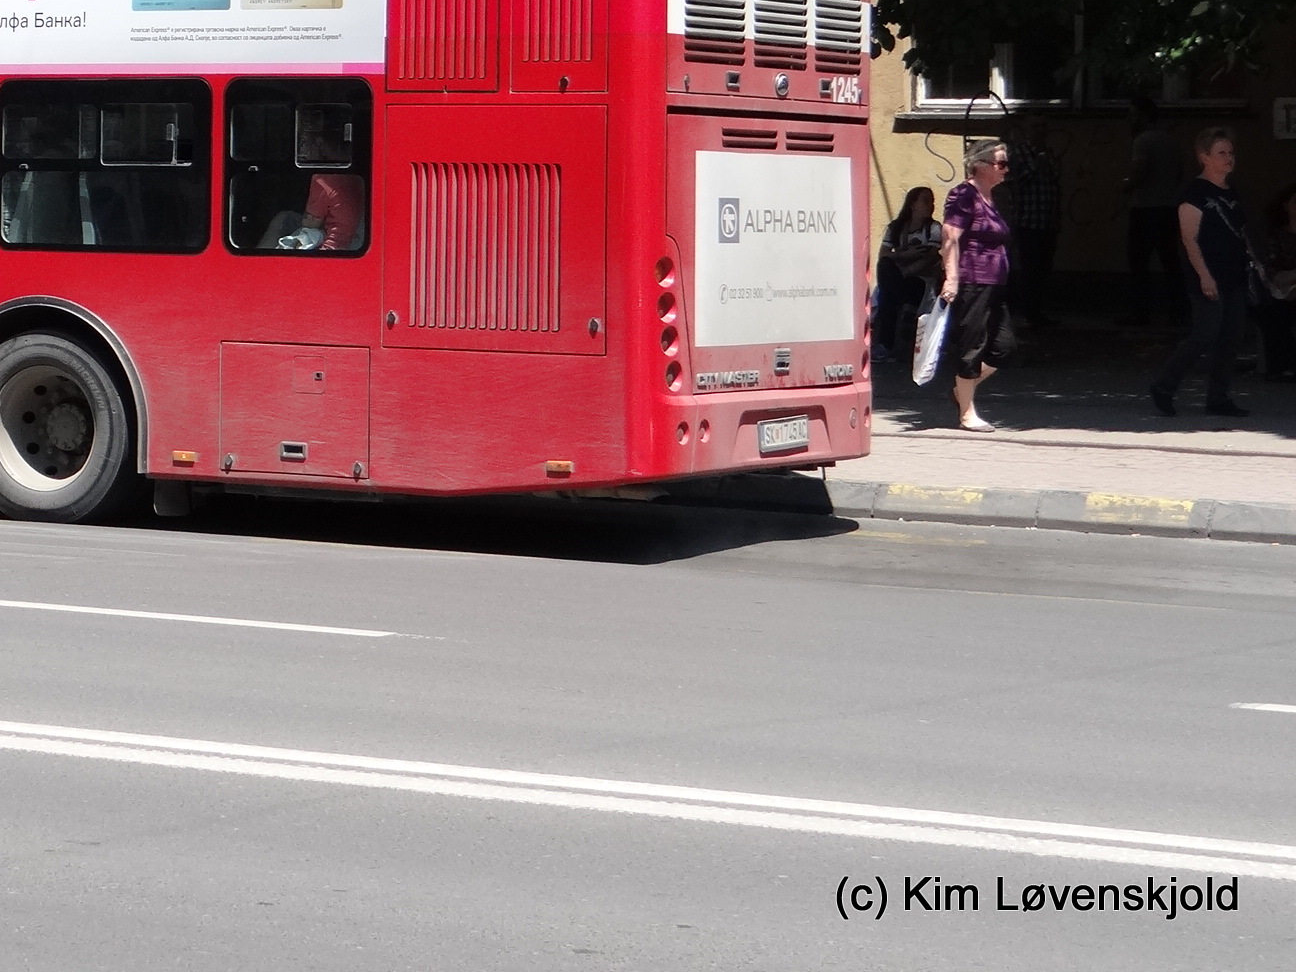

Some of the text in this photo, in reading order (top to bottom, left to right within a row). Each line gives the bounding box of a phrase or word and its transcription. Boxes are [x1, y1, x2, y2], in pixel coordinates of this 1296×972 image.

[34, 12, 86, 28] Банка!
[831, 77, 859, 103] 1245
[744, 209, 837, 233] ALPHA BANK
